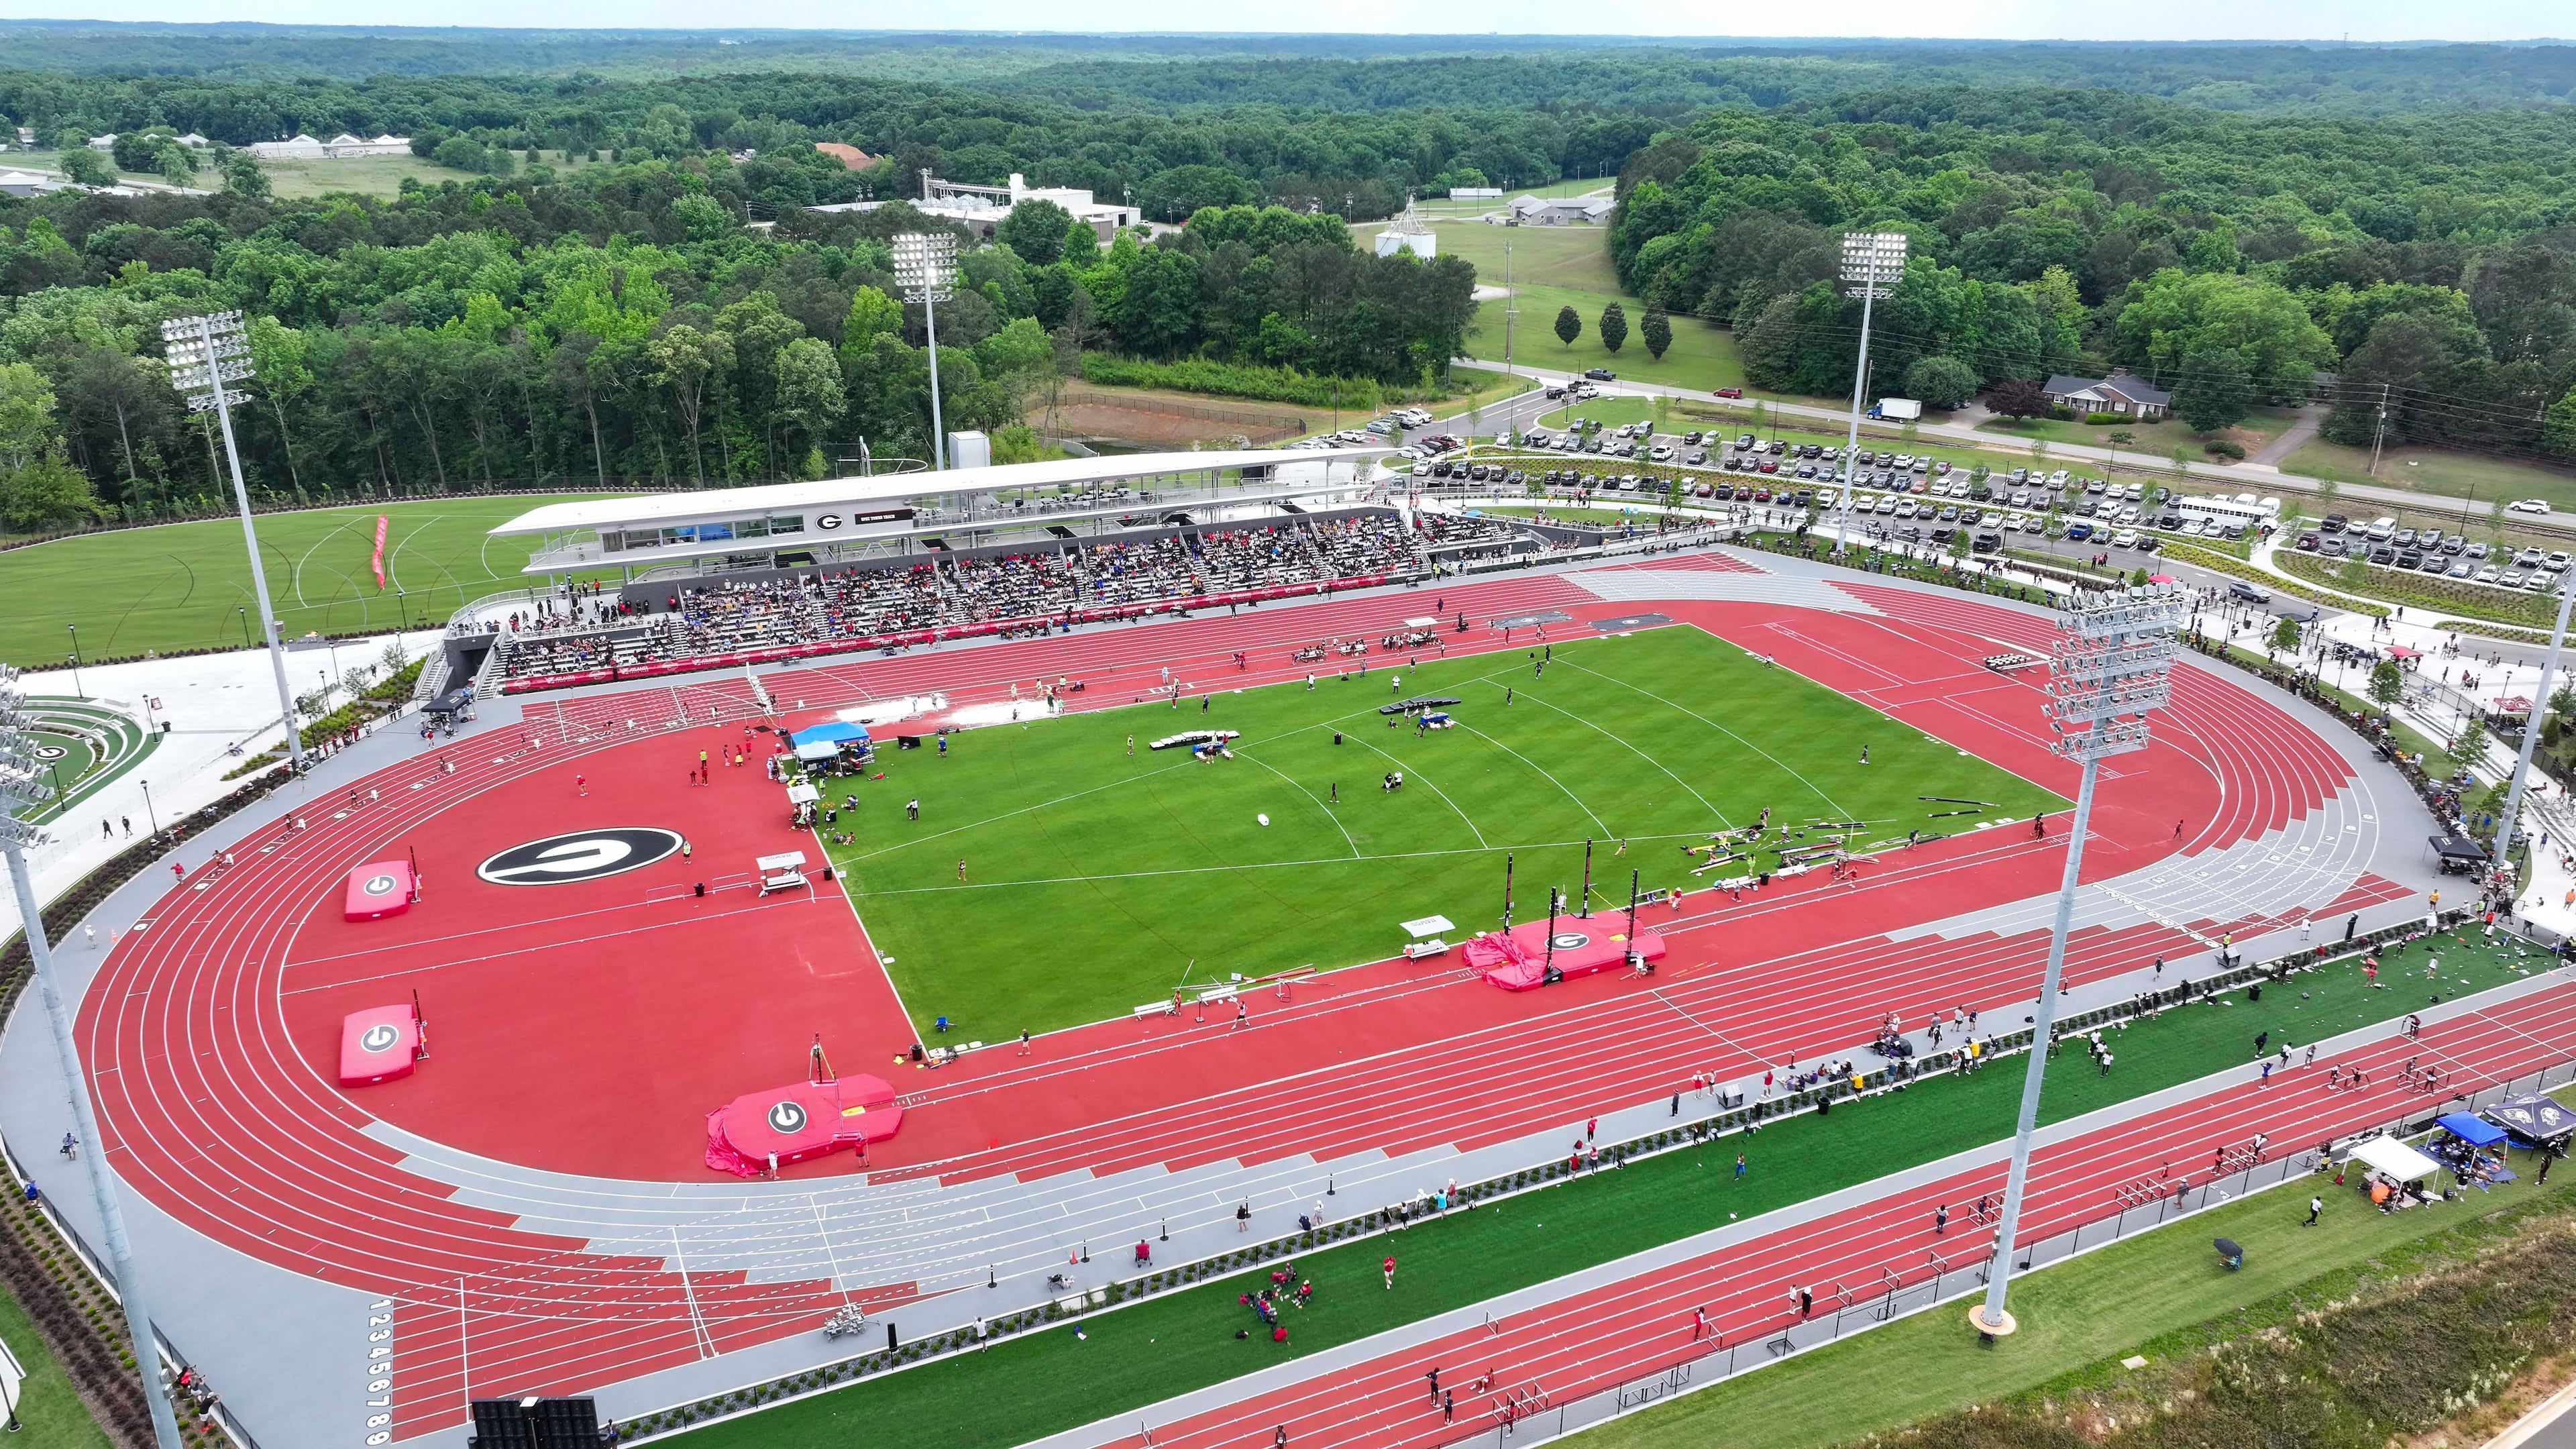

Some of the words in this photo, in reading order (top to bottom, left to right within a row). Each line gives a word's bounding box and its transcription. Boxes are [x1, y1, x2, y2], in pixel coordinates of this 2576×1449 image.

[816, 513, 843, 531] G
[480, 828, 681, 884] G
[364, 875, 396, 896] G
[1544, 933, 1590, 950] G
[361, 1025, 399, 1053] G
[767, 1101, 807, 1134] G
[369, 1299, 392, 1310] 1
[368, 1313, 392, 1327] 2
[368, 1328, 392, 1342] 3
[368, 1346, 392, 1359] 4
[367, 1360, 392, 1375] 5
[367, 1378, 392, 1393] 6
[366, 1394, 391, 1407] 7
[366, 1412, 391, 1428] 8
[365, 1430, 391, 1446] 9
